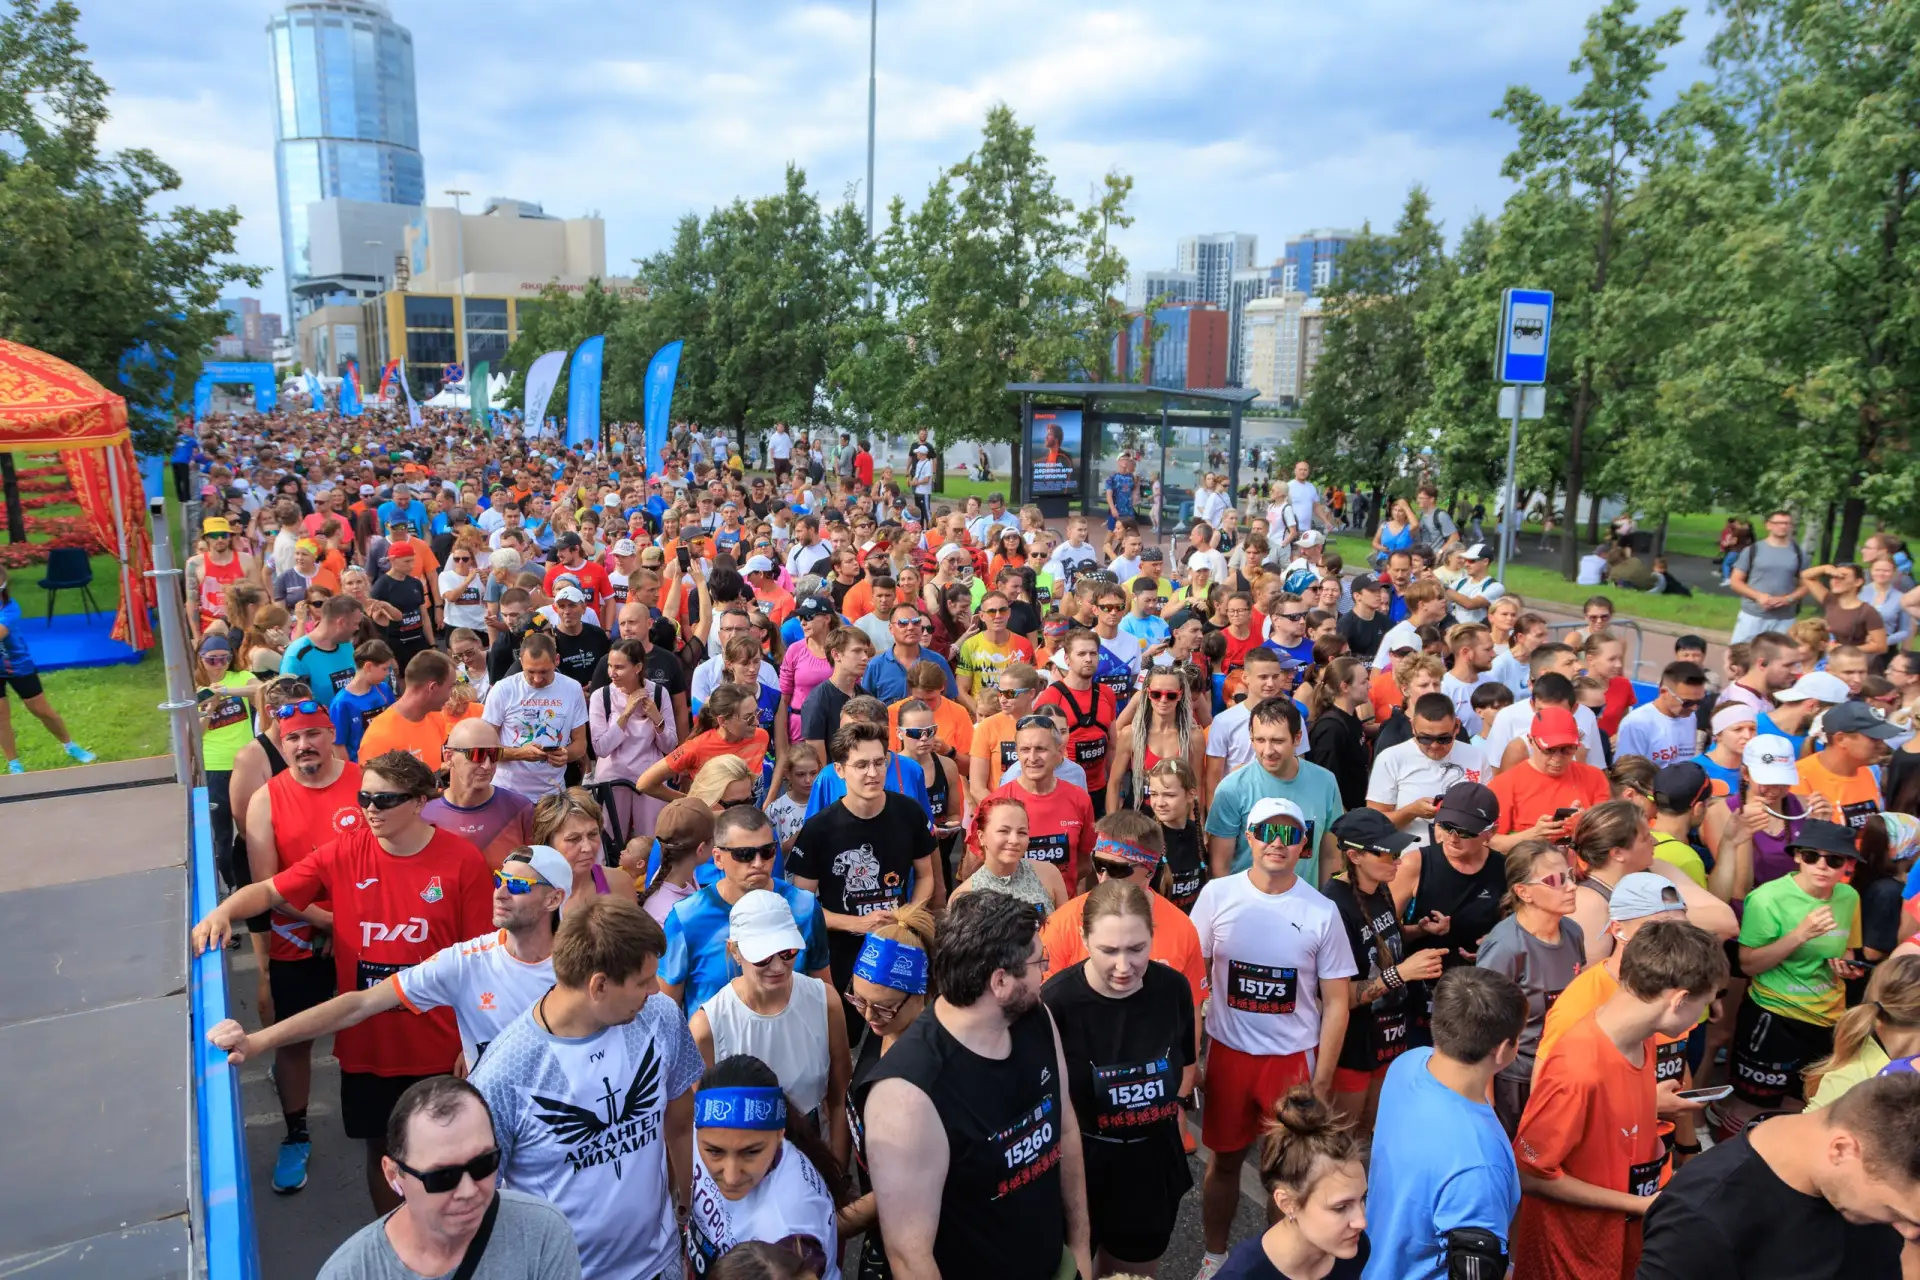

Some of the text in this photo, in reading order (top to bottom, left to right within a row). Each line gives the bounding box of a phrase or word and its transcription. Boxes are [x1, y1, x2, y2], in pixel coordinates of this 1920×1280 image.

[1238, 978, 1287, 997] 15173
[590, 1050, 605, 1063] rw
[1738, 1063, 1788, 1085] 17092
[1108, 1079, 1165, 1106] 15261
[564, 1110, 661, 1164] АРХАНГЕЛ
[1004, 1122, 1053, 1169] 15260
[573, 1127, 657, 1175] МИХАИЛ
